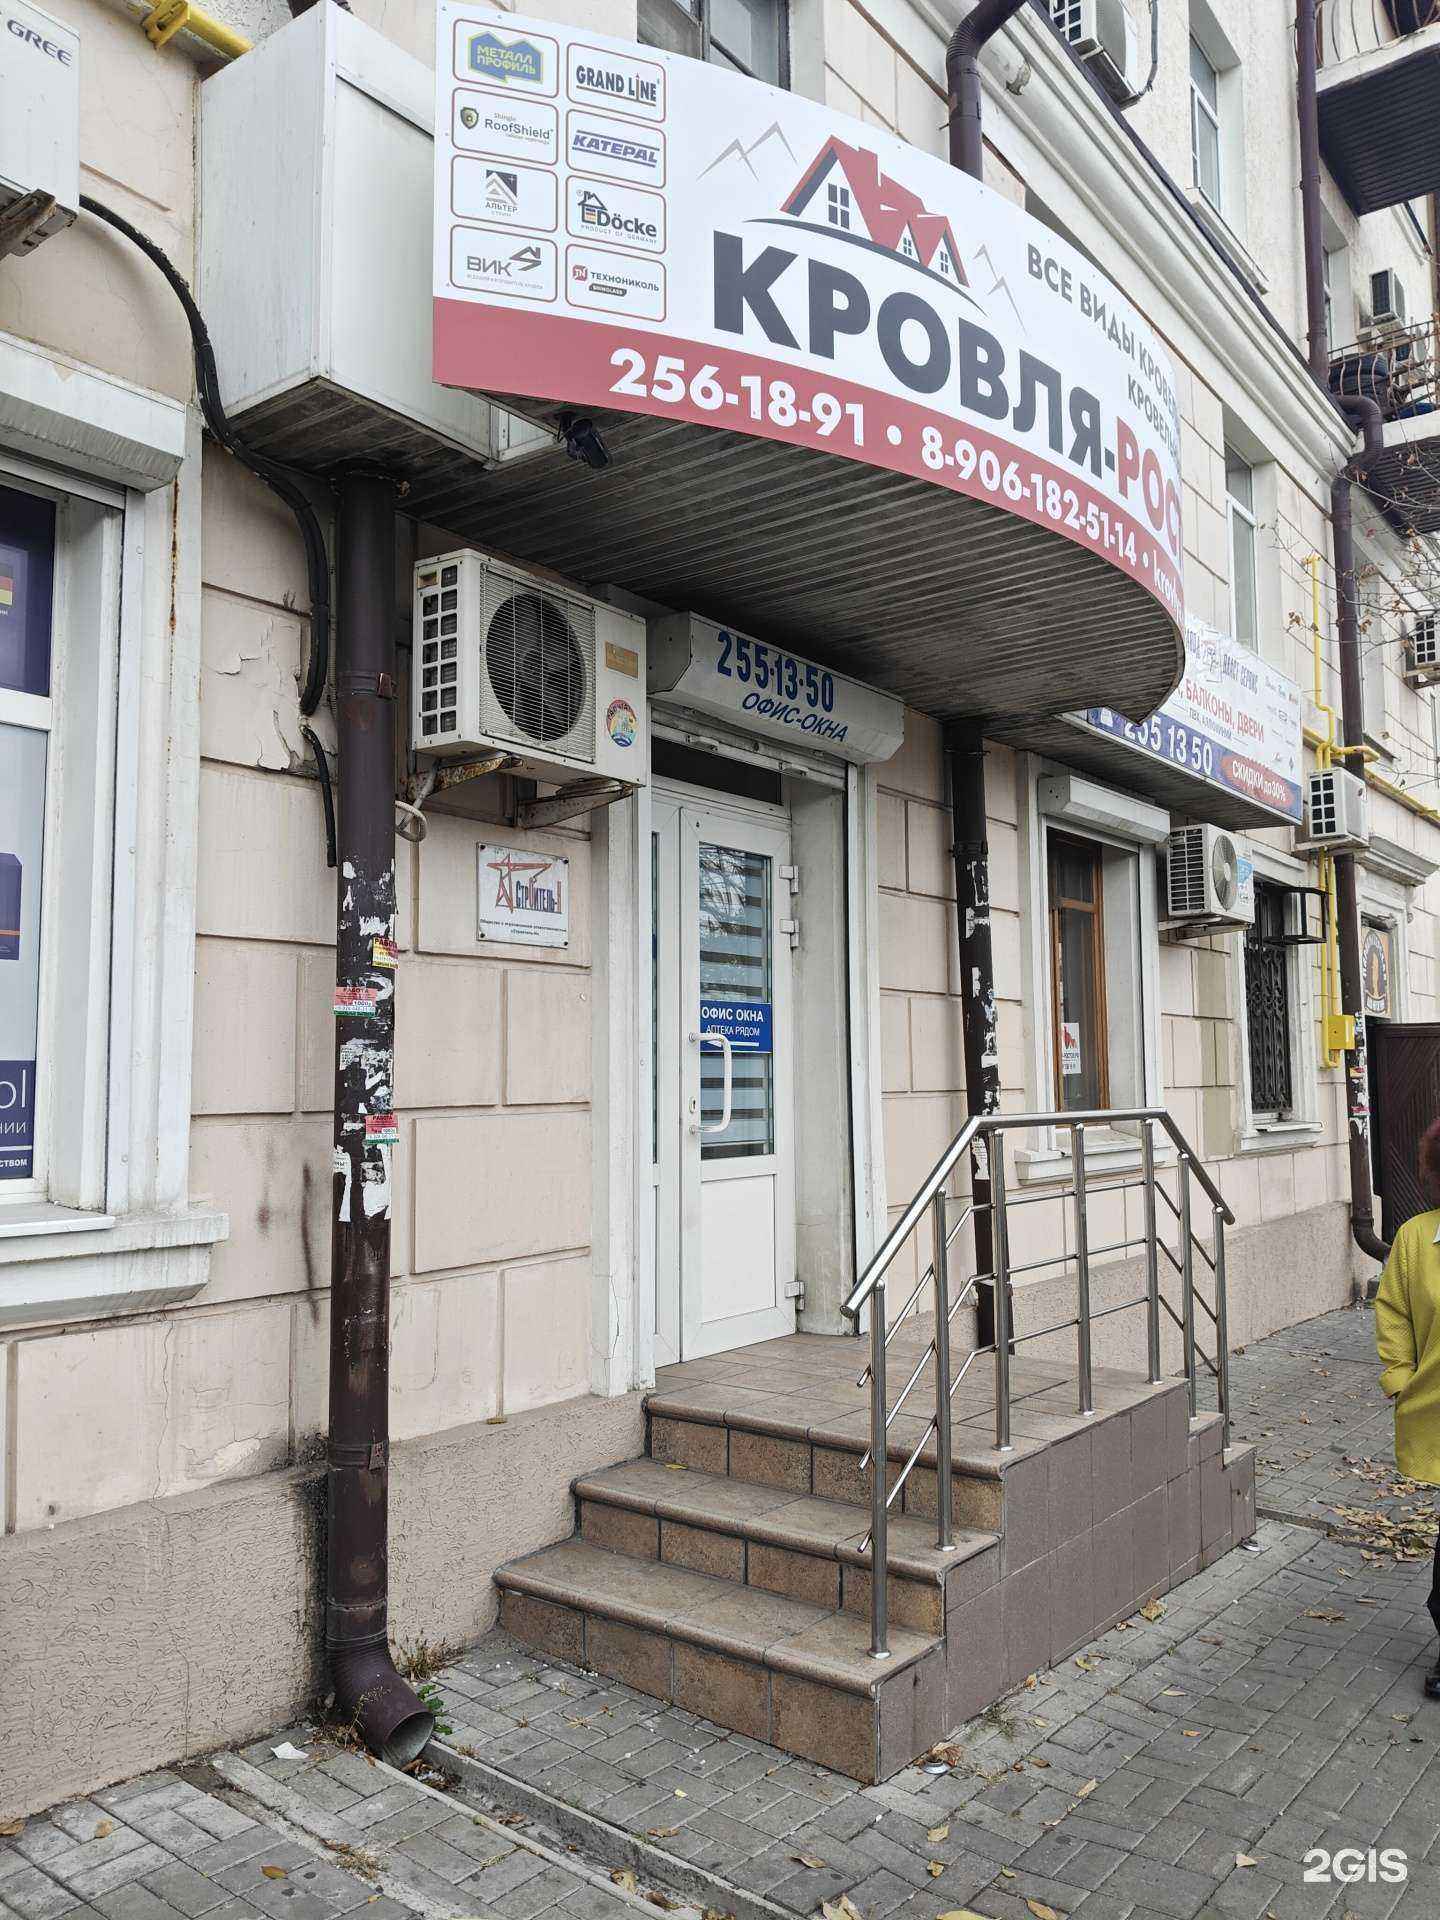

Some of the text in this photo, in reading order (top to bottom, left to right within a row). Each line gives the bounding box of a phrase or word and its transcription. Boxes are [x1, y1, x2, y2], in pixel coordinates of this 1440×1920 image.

[7, 19, 73, 68] GREE
[476, 45, 533, 65] МЕТАЛЛ
[476, 56, 536, 75] ПРОФИЛЬ
[576, 65, 625, 93] GRAND
[484, 118, 551, 140] RoofShield
[573, 134, 658, 164] KATEPAL
[485, 201, 518, 214] АЛЬТЕР
[596, 208, 657, 238] Döcke
[466, 255, 513, 277] ВИК
[590, 271, 660, 292] ТЕХНОНИКОЛЬ
[1028, 243, 1073, 304] ВСЕ
[1080, 282, 1136, 361] ВИДЫ
[609, 347, 865, 448] 256-18-91
[921, 425, 1137, 567] 8-906-182-51-14
[741, 691, 849, 743] ОФИС-ОКНА
[1185, 678, 1235, 729] БАЛКОНЫ,
[1236, 711, 1265, 744] ДВЕРИ
[1168, 724, 1187, 764] 13
[1191, 735, 1213, 776] 50
[1232, 759, 1264, 792] СКИДКИ
[701, 1006, 764, 1023] ОФИС ОКНА
[706, 1024, 760, 1038] АПТЕКА РЯДОМ
